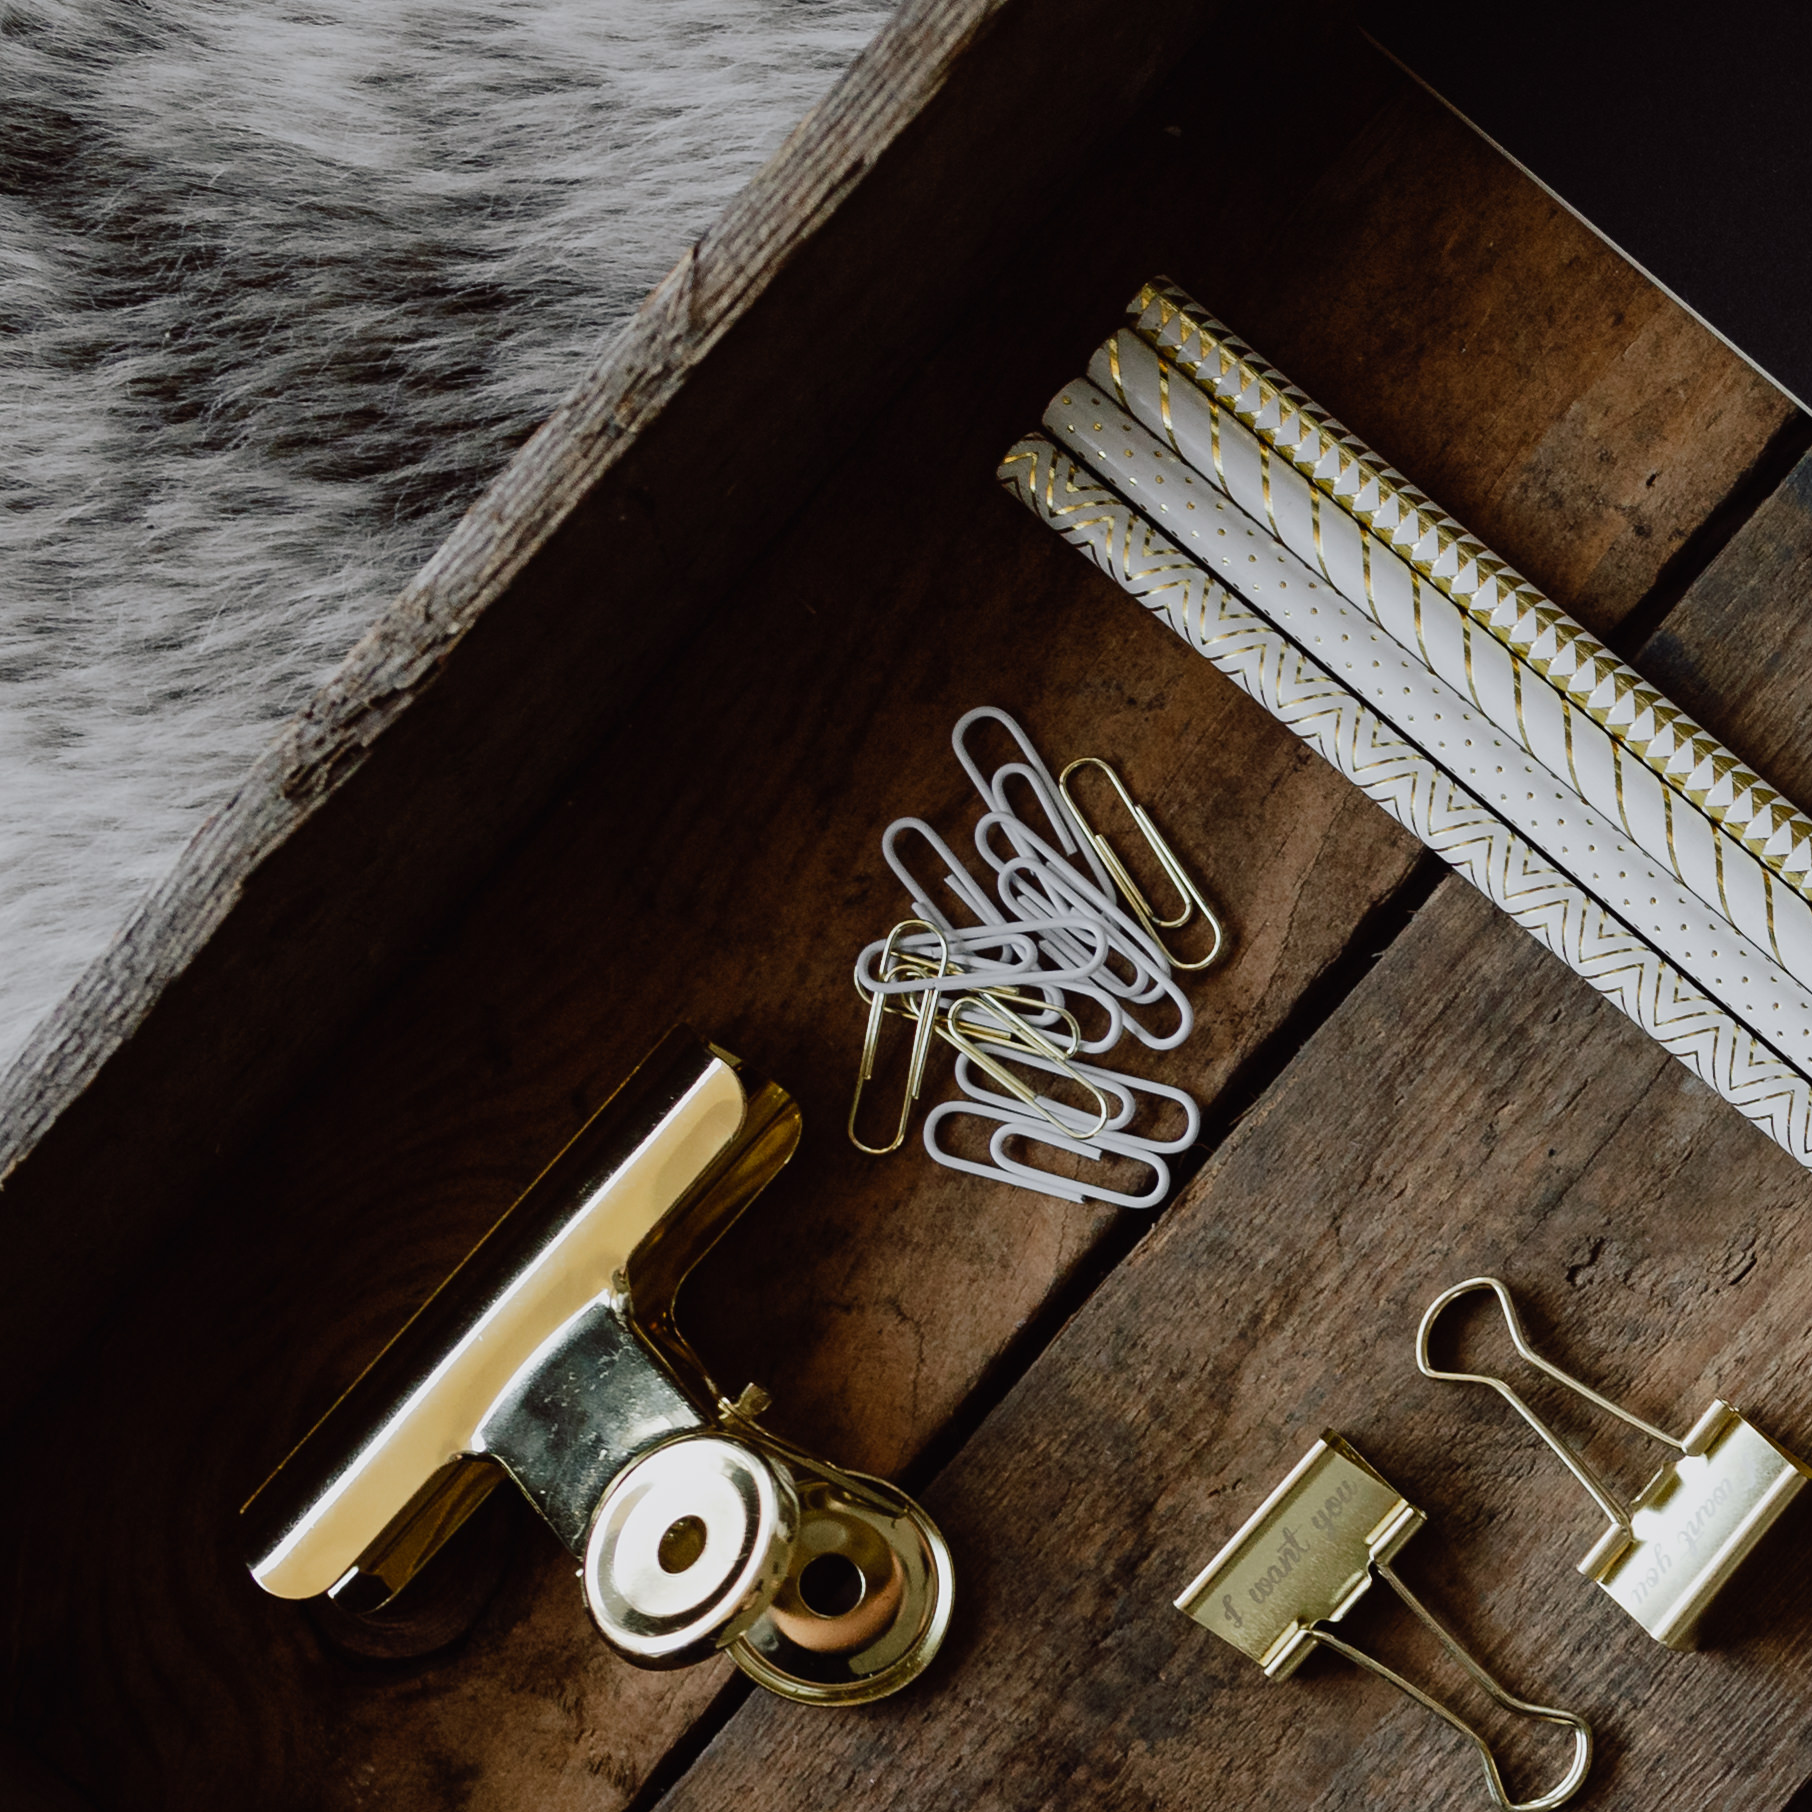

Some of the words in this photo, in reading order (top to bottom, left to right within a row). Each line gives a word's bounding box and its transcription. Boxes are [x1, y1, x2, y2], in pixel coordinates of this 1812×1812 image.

[1222, 1593, 1243, 1629] I
[1249, 1526, 1311, 1605] want
[1311, 1479, 1360, 1541] you
[1677, 1477, 1734, 1558] want
[1631, 1542, 1672, 1604] you
